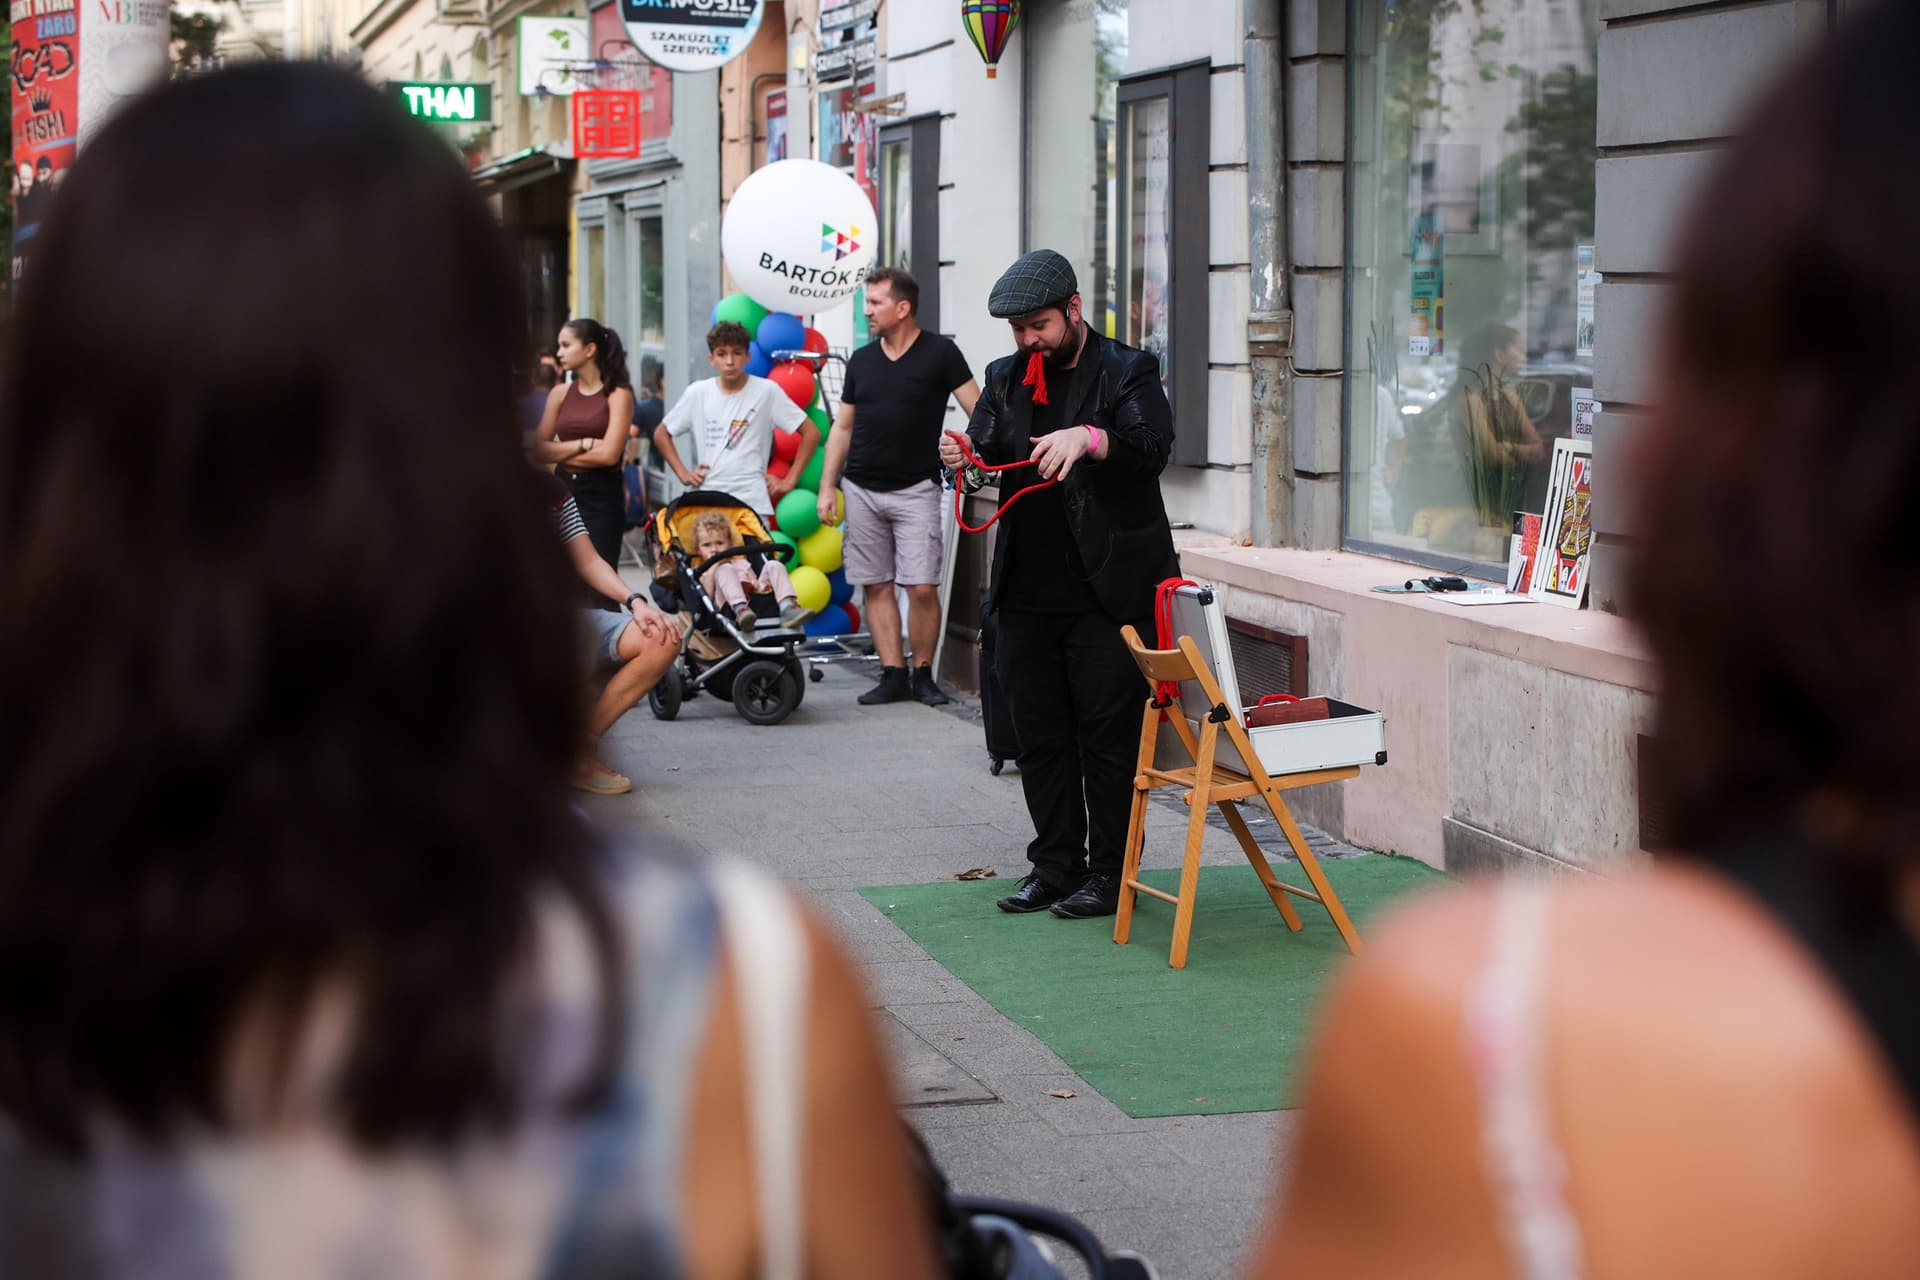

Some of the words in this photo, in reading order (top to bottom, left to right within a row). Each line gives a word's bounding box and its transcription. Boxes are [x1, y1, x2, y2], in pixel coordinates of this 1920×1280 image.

[651, 31, 730, 44] SZAKÜZLET
[662, 44, 718, 56] SZERVIZ
[402, 86, 475, 119] THAI
[759, 251, 851, 287] BARTÓK
[788, 284, 861, 299] BOULEVA
